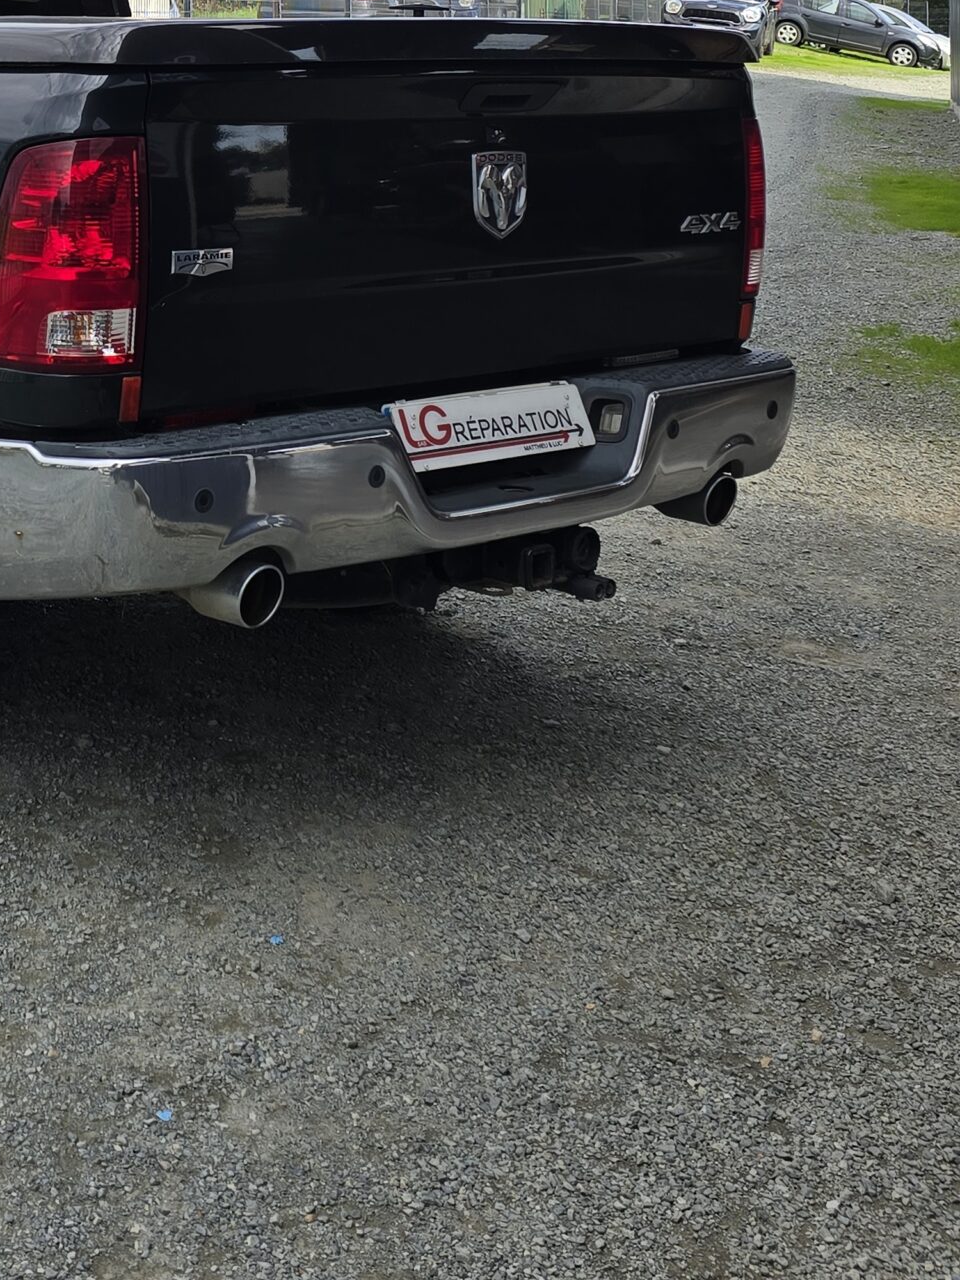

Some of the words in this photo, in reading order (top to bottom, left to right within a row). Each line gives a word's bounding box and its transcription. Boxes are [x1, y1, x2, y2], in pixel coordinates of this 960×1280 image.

[680, 211, 742, 234] 4X4
[176, 251, 232, 263] LARAMIE
[398, 404, 453, 449] LG
[452, 406, 573, 443] RÉPARATION
